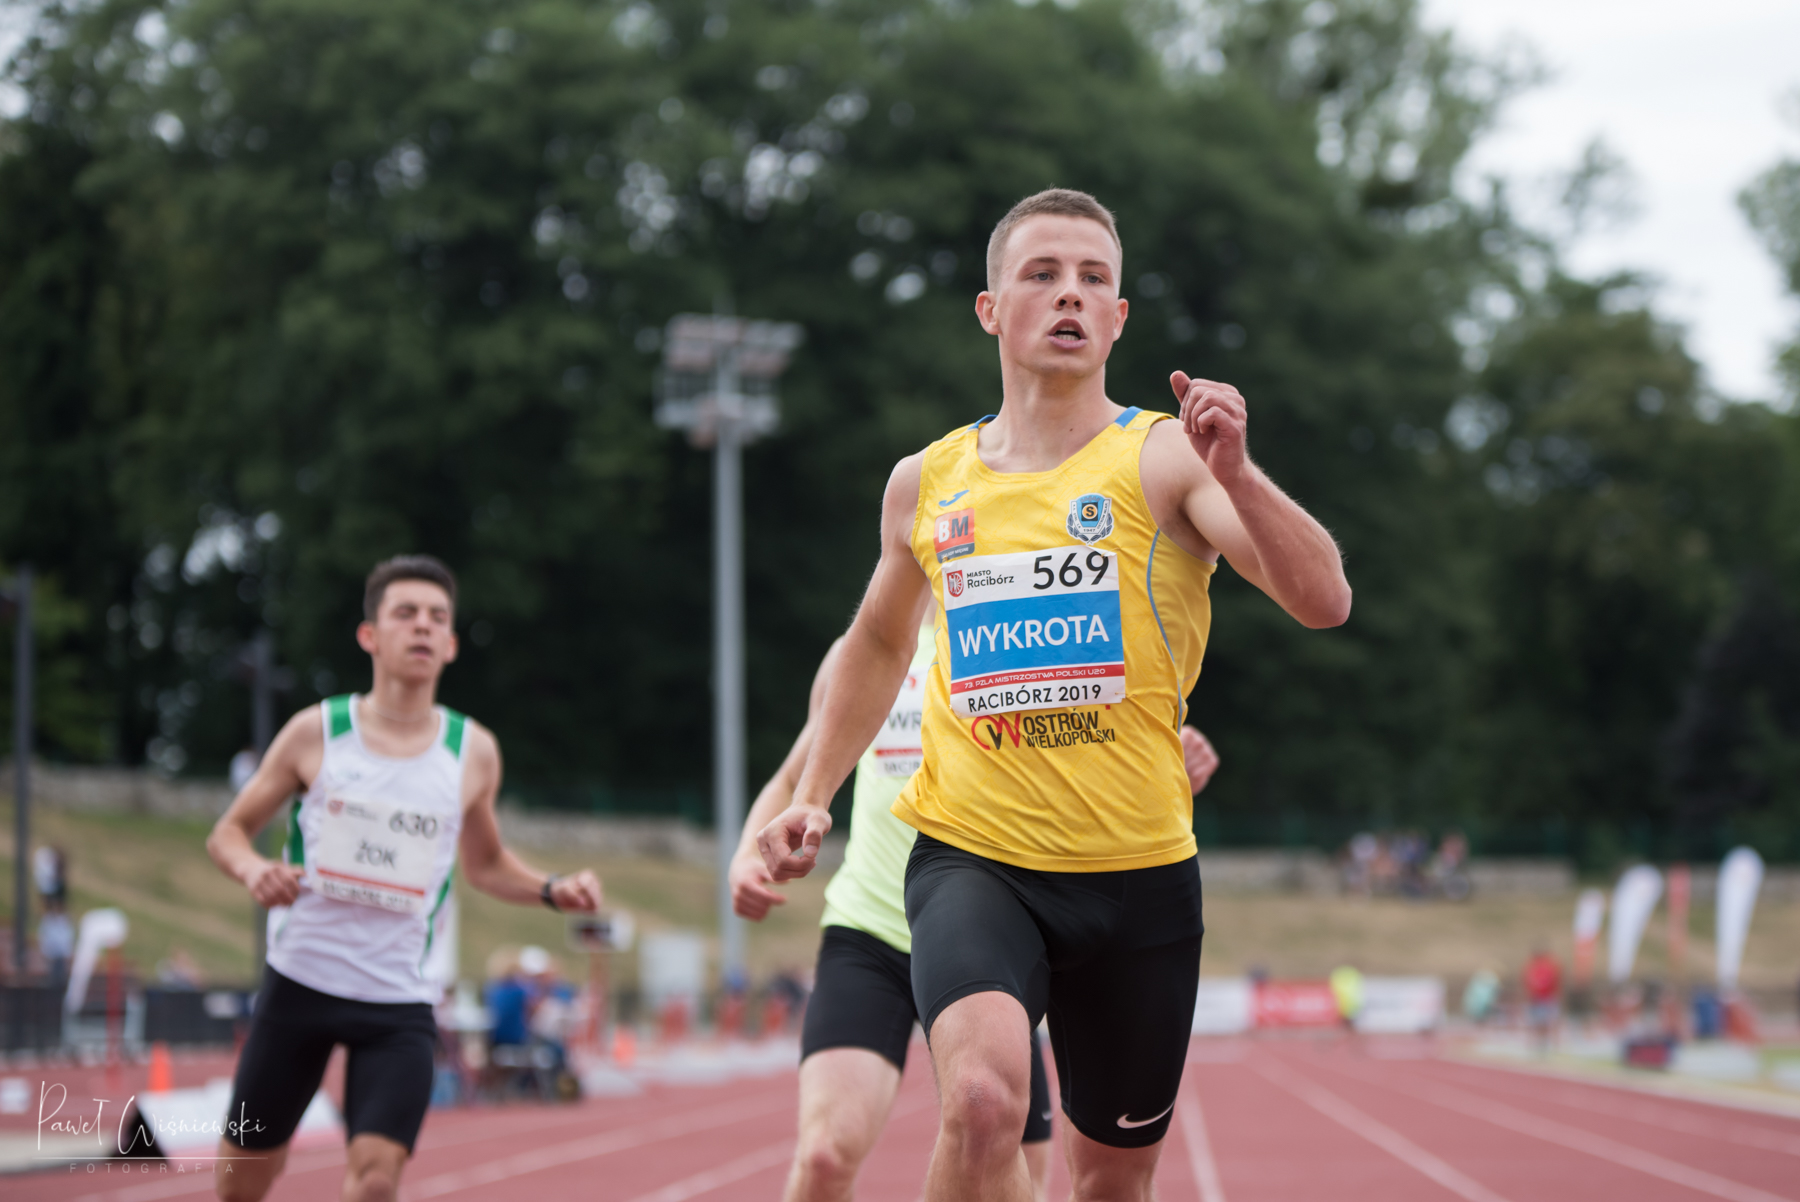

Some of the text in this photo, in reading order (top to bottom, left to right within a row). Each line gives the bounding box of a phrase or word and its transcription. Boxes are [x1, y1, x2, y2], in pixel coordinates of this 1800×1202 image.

[1085, 506, 1095, 517] S
[938, 515, 969, 543] BM
[966, 569, 992, 578] MIASTO
[967, 574, 1015, 589] Racibórz
[1033, 550, 1109, 590] 569
[958, 614, 1110, 658] WYKROTA
[975, 678, 994, 687] PZLA
[995, 671, 1055, 684] MISTRZOSTWA
[1056, 669, 1086, 678] POLSKI
[967, 684, 1102, 713] RACIBÓRZ 2019
[1022, 708, 1099, 736] OSTRÓW
[1022, 728, 1116, 749] WIELKOPOLSKI
[389, 810, 438, 839] 630
